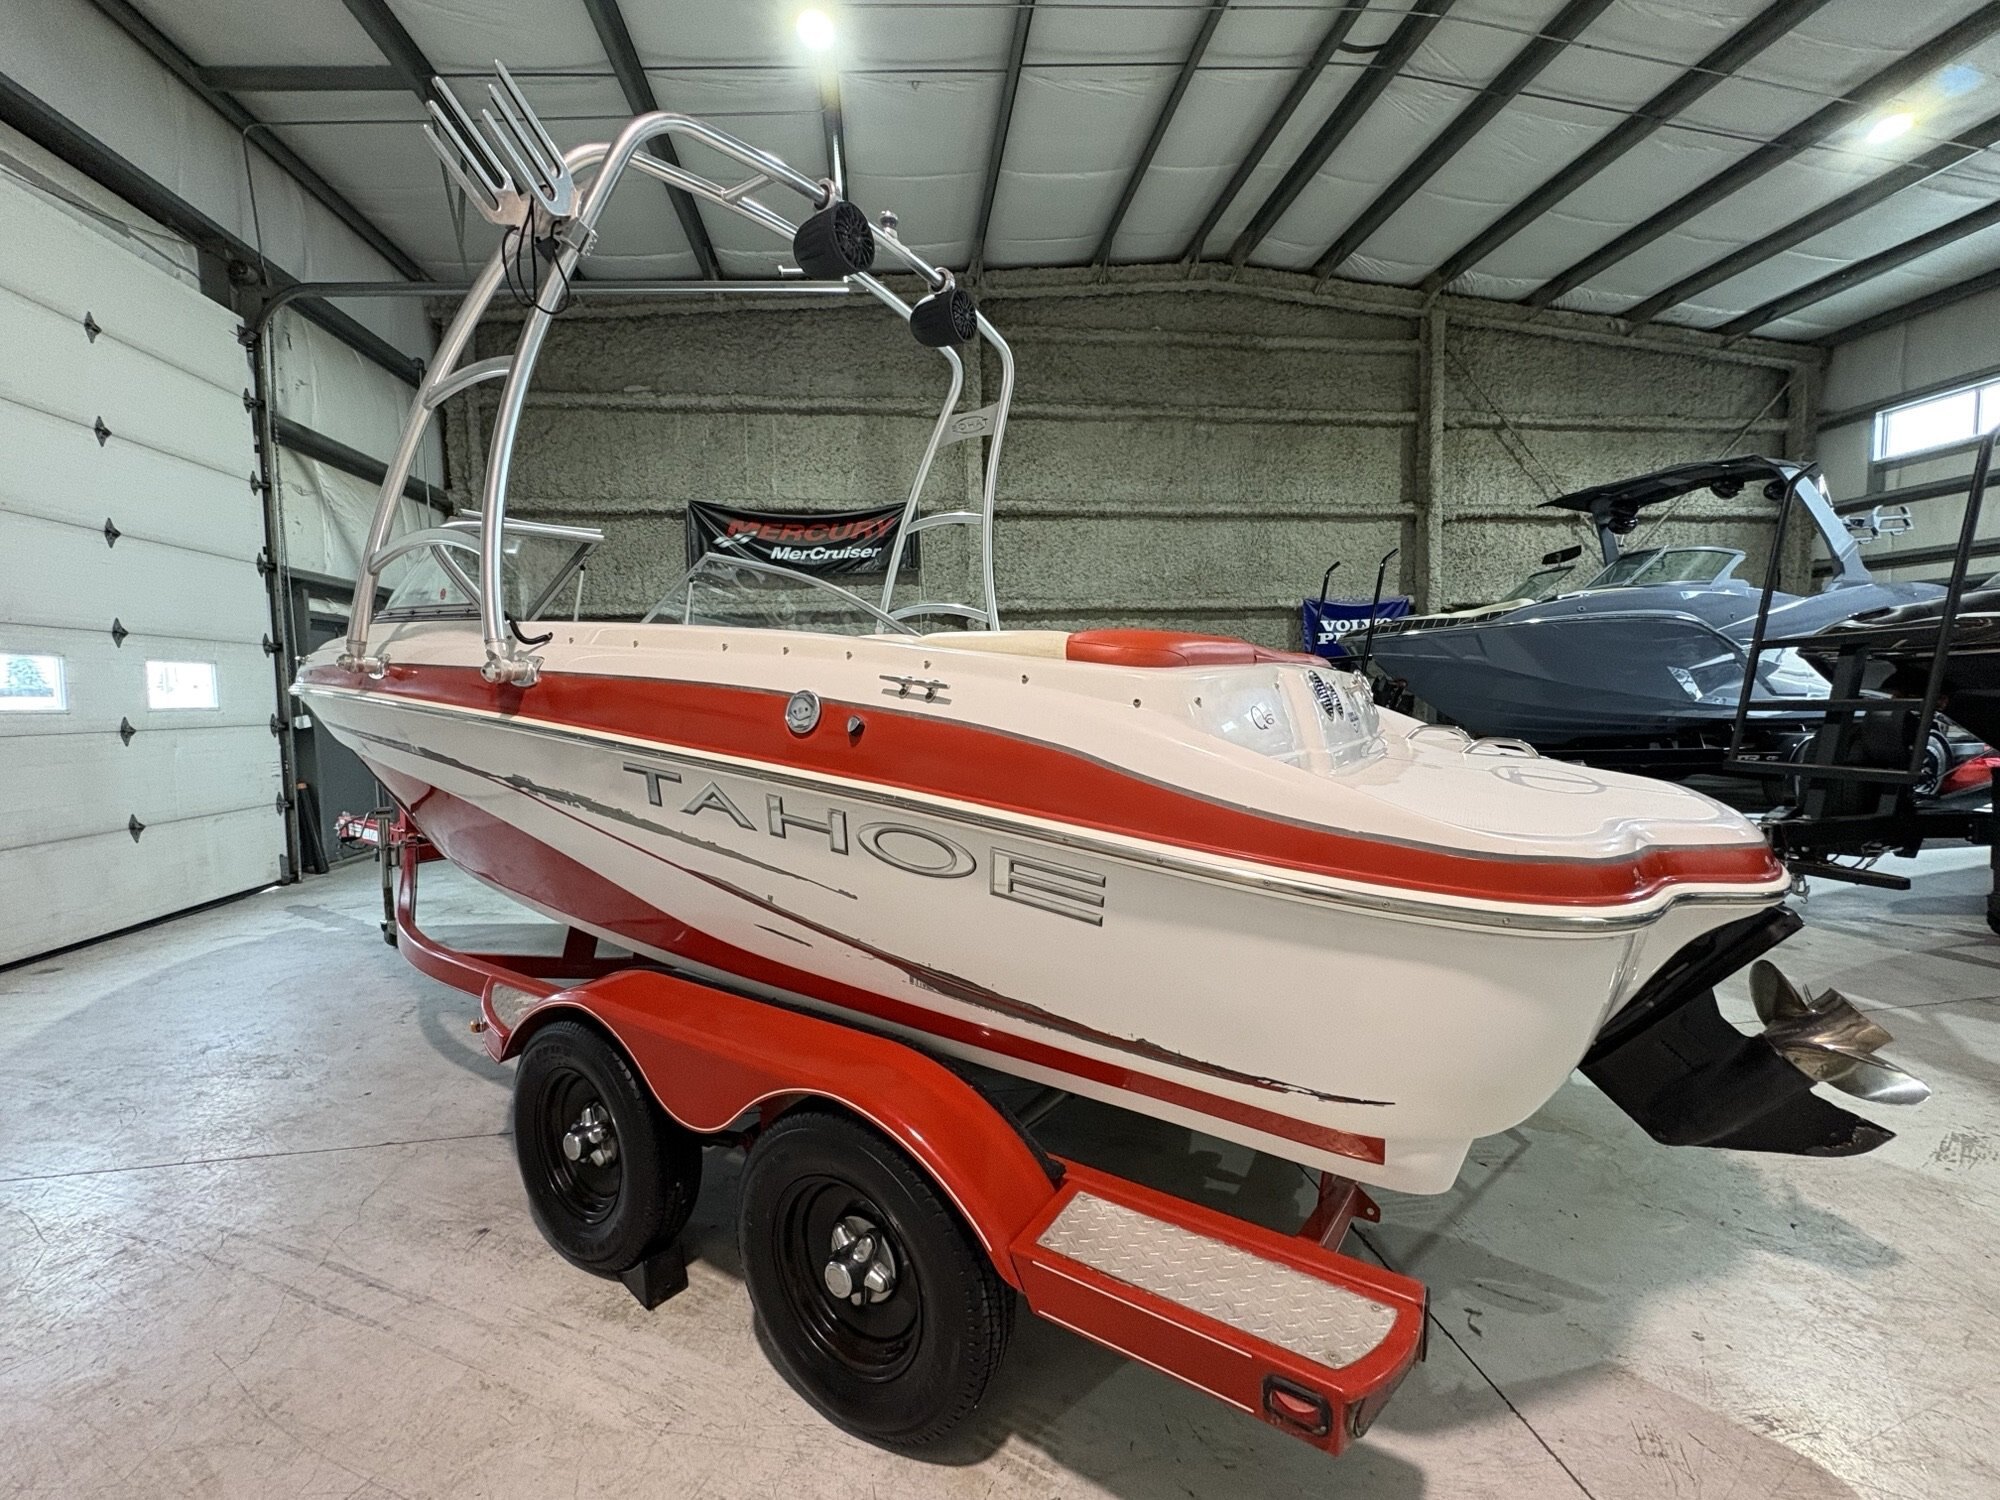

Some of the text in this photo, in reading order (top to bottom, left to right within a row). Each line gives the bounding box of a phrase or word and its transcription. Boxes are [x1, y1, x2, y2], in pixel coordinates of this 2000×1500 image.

[726, 517, 895, 542] MERCURY
[770, 546, 882, 560] MerCruiser
[622, 762, 1107, 927] TAHOE
